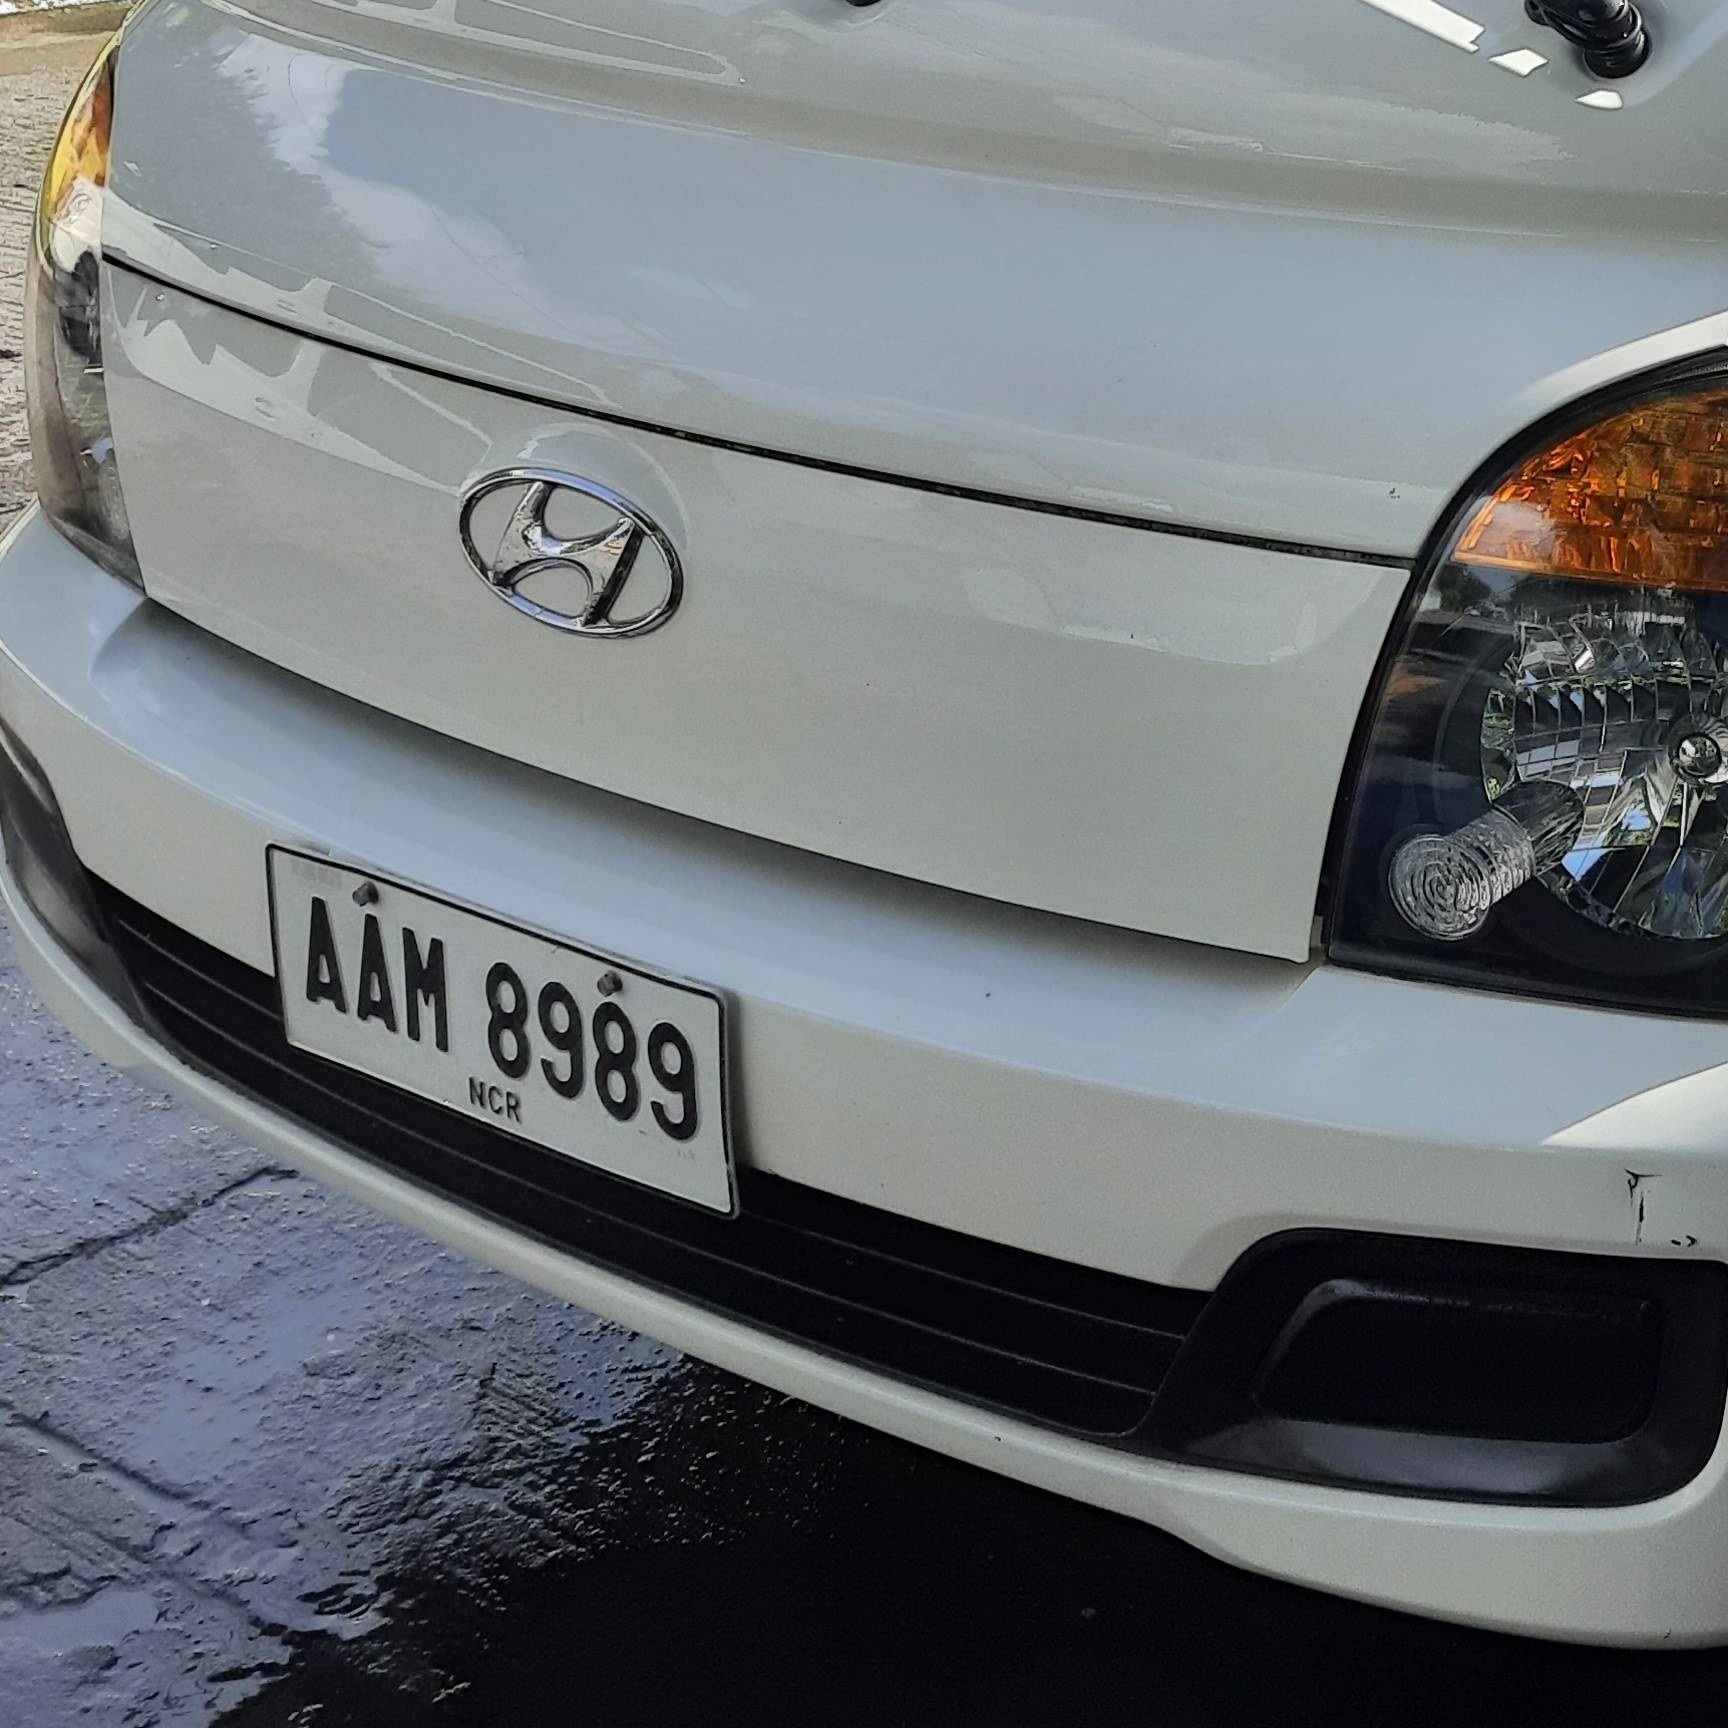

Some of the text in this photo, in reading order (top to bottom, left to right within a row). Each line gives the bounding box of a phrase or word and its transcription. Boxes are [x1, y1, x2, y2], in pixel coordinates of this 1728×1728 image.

[305, 895, 699, 1144] AAM 8989
[467, 1076, 523, 1125] NCR
